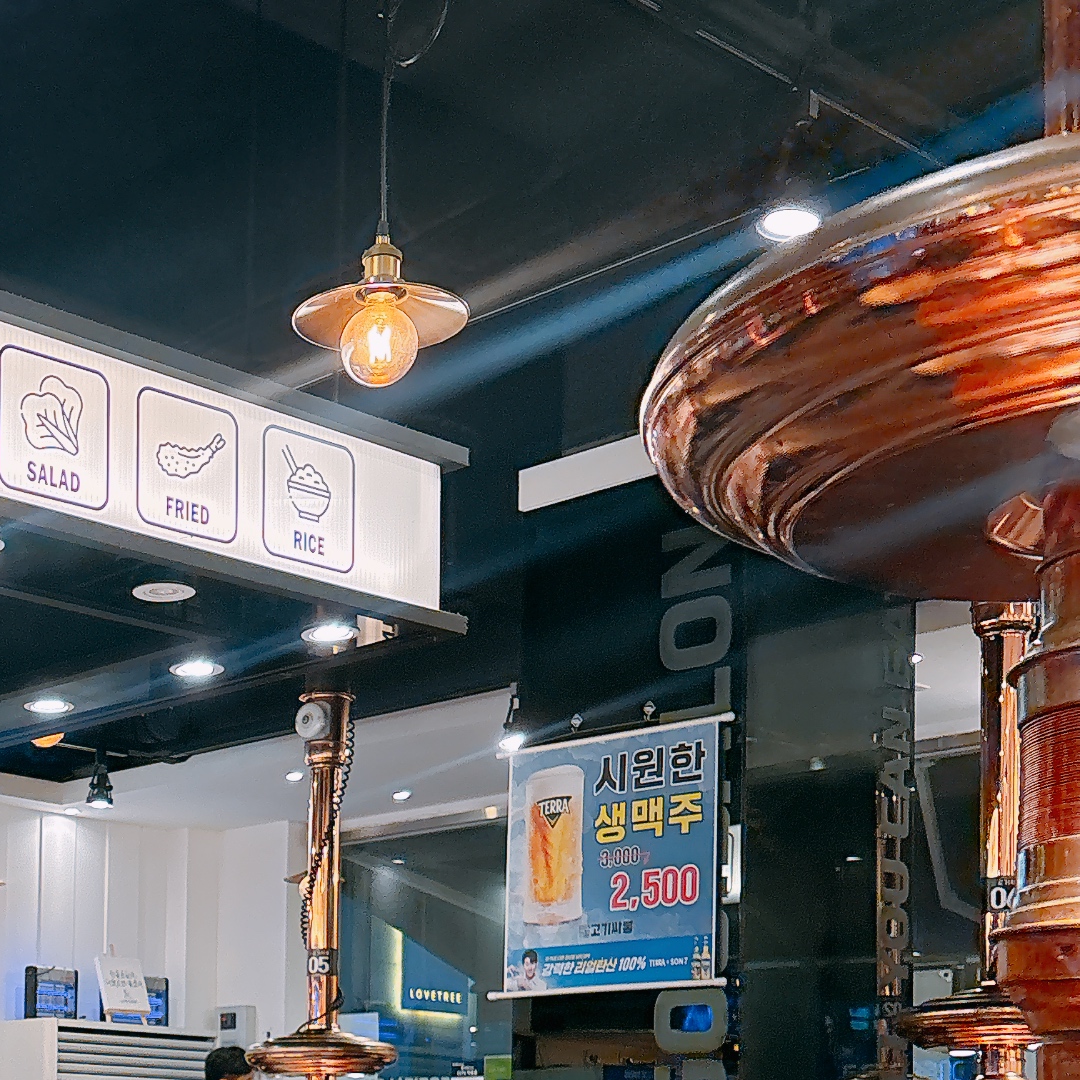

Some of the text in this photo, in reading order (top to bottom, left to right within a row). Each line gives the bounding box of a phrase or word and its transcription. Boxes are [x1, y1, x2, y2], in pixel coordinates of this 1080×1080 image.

[27, 461, 82, 494] SALAD
[165, 495, 211, 526] FRIED
[293, 529, 326, 556] RICE
[593, 740, 708, 796] 시원한
[537, 798, 571, 816] TERRA
[594, 792, 703, 845] 생맥주
[600, 846, 640, 868] 3,000
[609, 864, 700, 912] 2,500
[309, 956, 329, 974] 05
[619, 955, 646, 972] 100%
[410, 988, 463, 1004] LOVETREE
